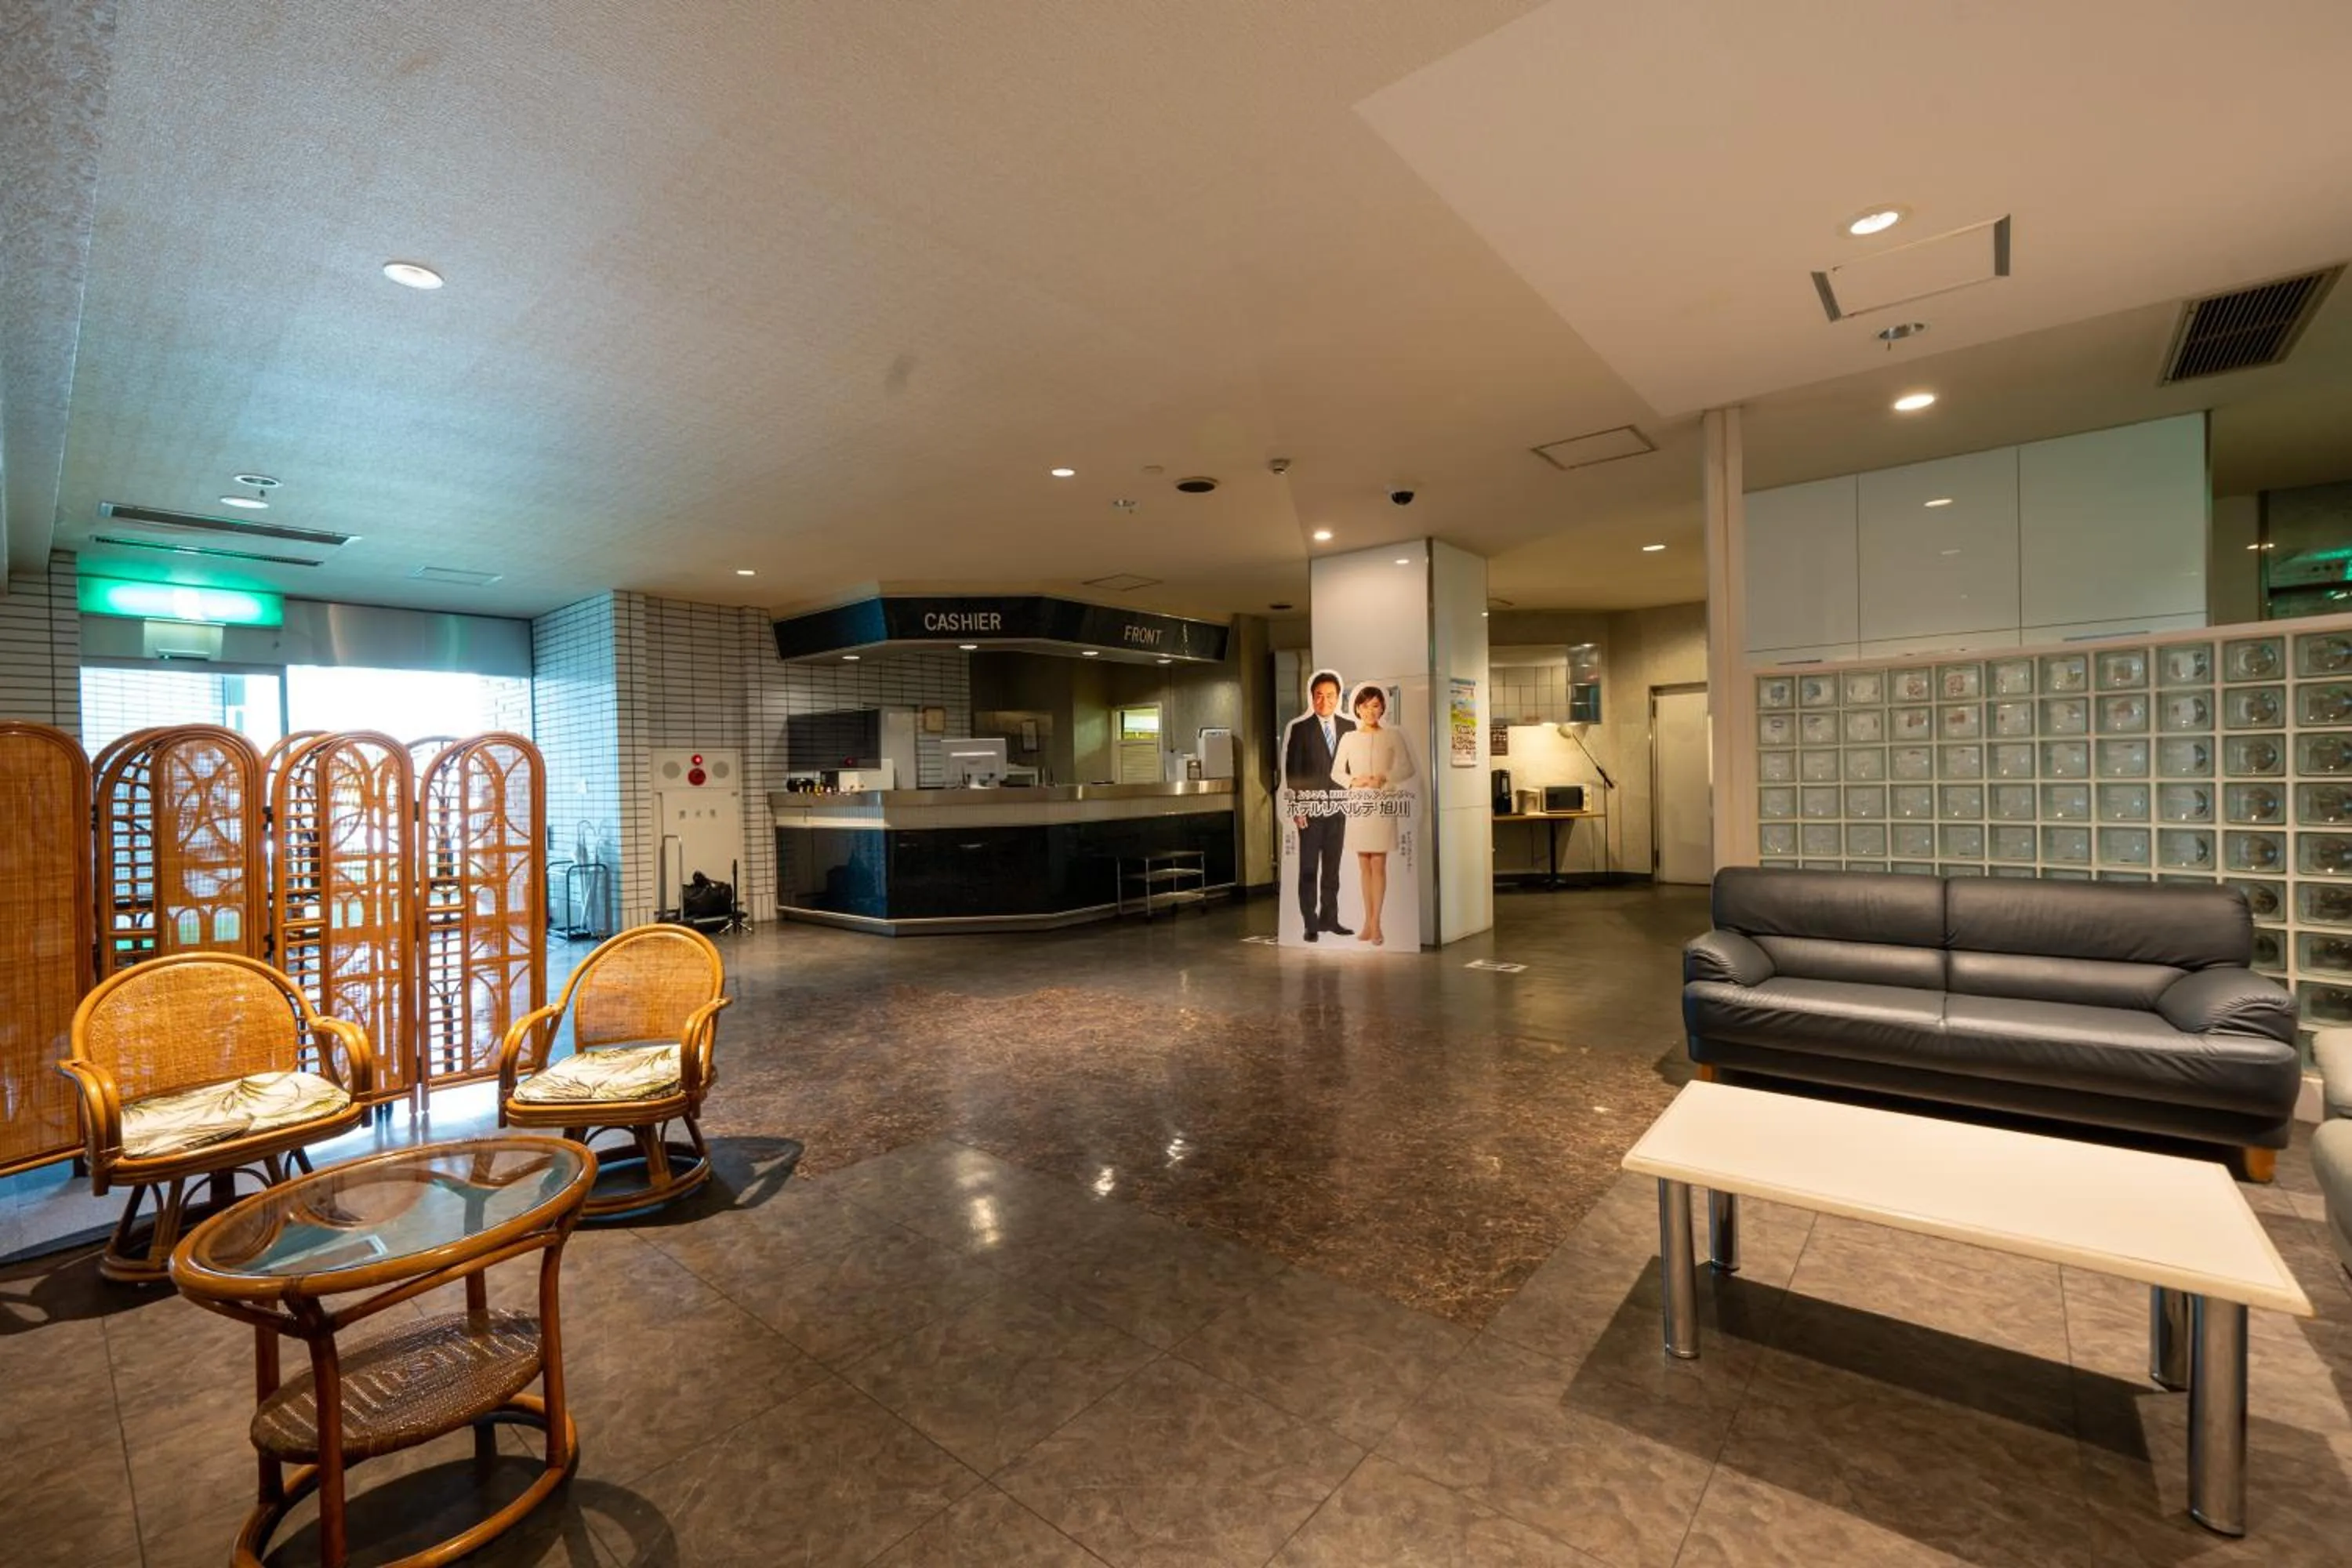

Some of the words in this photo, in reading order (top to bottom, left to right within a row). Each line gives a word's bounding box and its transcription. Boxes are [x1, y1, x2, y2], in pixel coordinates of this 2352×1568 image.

[924, 612, 1002, 631] CASHIER
[1124, 625, 1163, 645] FRONT
[1287, 800, 1374, 816] ホテルリベルテ
[1379, 800, 1410, 816] 旭川
